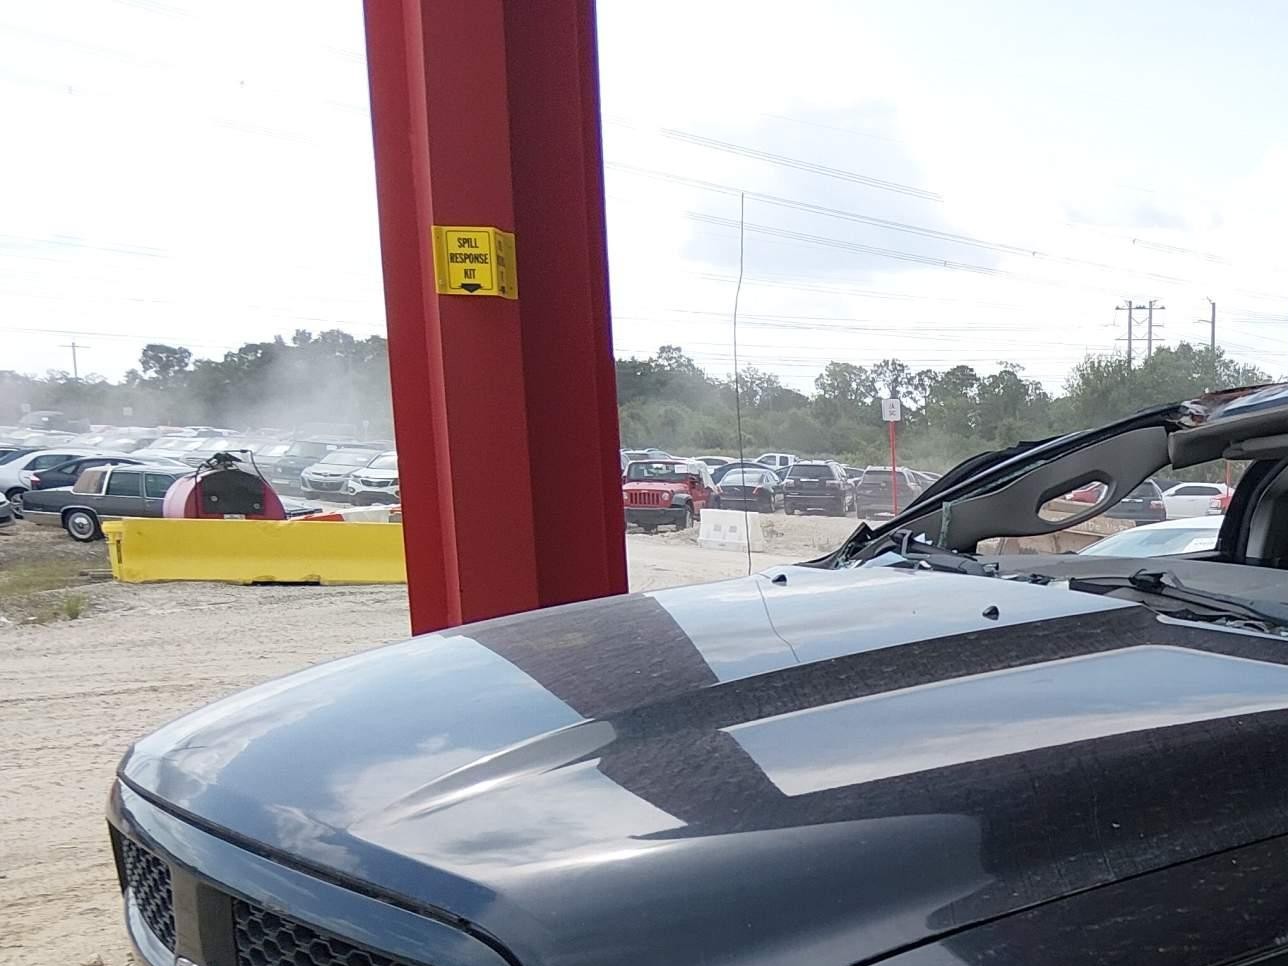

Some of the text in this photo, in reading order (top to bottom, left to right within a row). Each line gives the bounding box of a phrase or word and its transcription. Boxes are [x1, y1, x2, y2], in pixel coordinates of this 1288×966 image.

[457, 237, 479, 249] SPILL
[449, 252, 489, 265] RESPONSE
[463, 268, 476, 280] KIT
